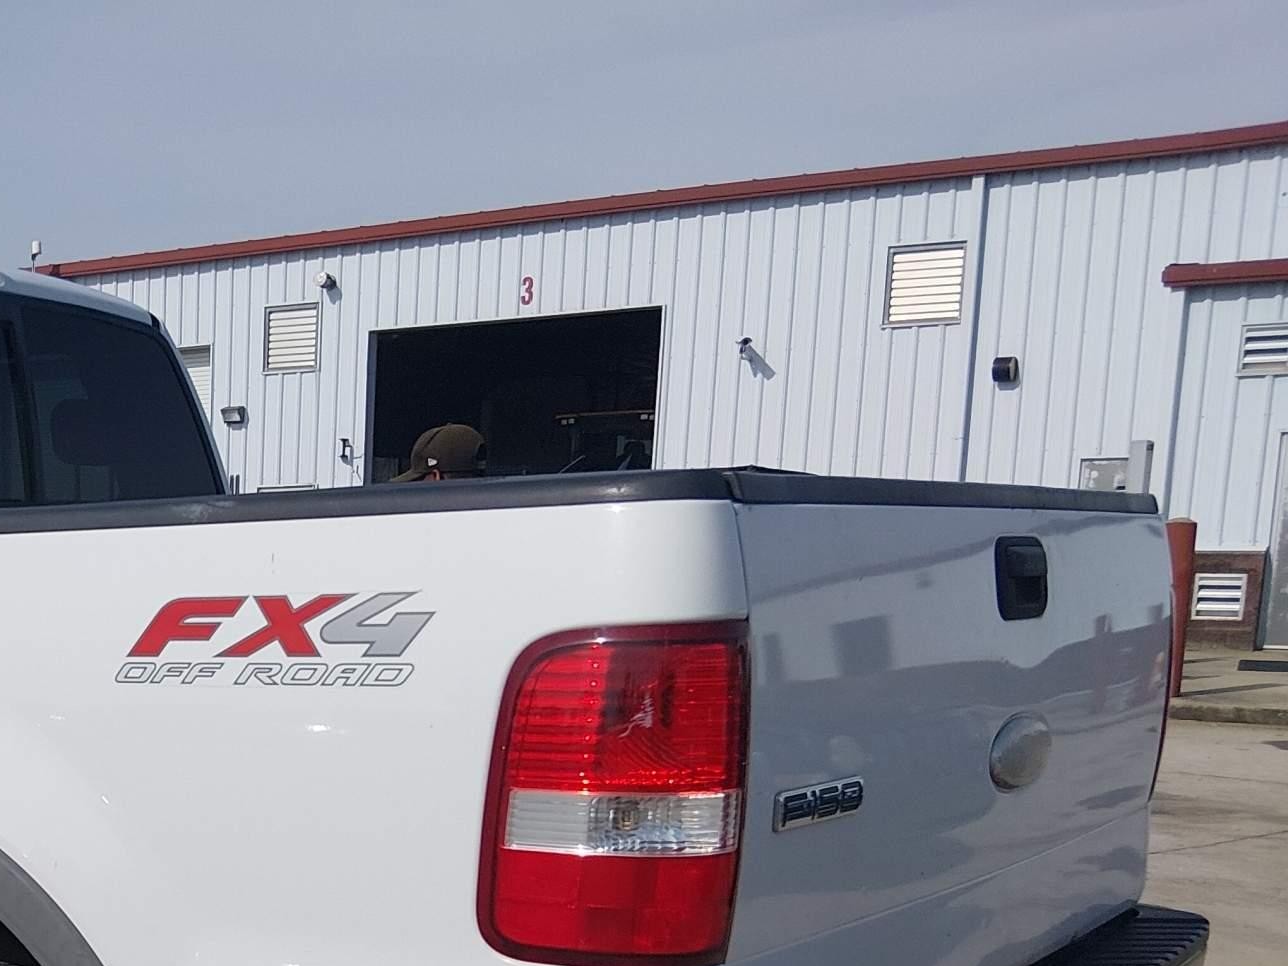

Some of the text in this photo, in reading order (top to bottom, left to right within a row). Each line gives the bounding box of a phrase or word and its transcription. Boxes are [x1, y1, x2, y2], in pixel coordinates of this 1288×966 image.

[520, 276, 534, 305] 3
[126, 590, 436, 658] FX4
[114, 661, 416, 687] OFF ROAD
